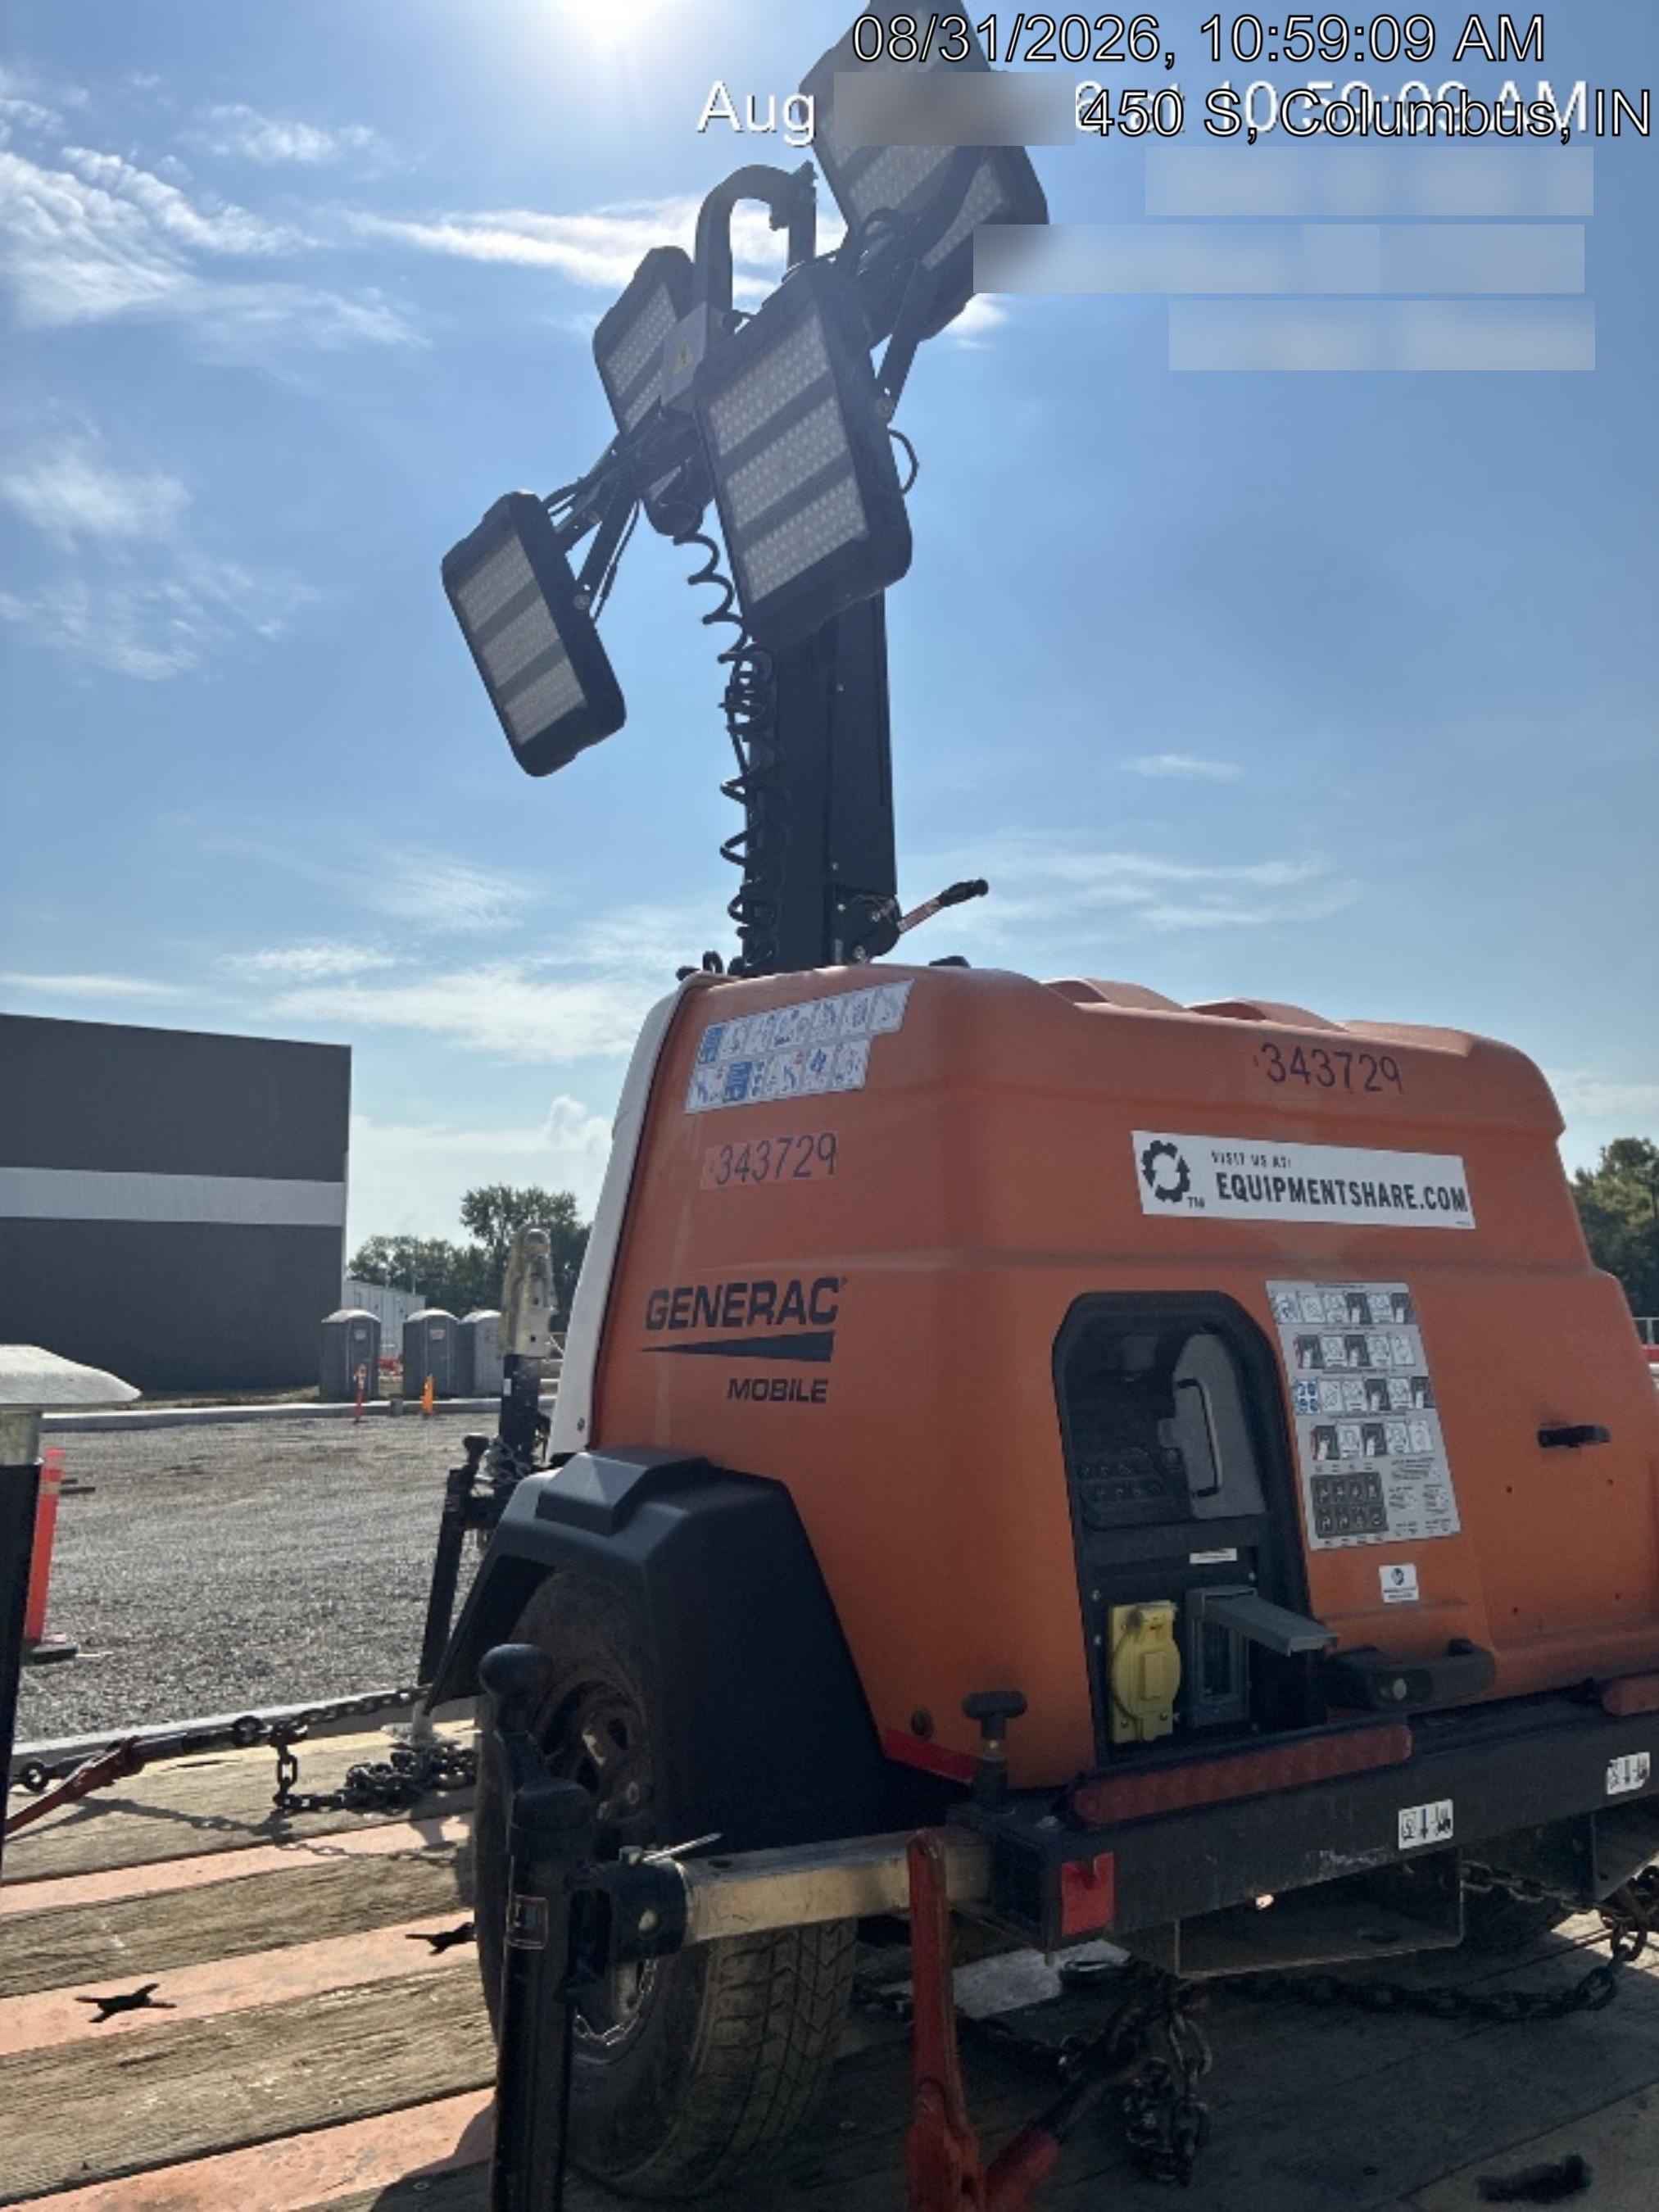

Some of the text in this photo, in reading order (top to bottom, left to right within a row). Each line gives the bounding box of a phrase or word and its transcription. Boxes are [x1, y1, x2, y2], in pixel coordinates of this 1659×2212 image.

[1262, 1043, 1403, 1094] 343729
[714, 1132, 837, 1185] 343729
[1211, 1150, 1244, 1165] VISIT
[1250, 1154, 1267, 1167] US
[1216, 1172, 1469, 1212] EQUIPMENTSHARE.COM
[646, 1276, 840, 1330] GENERAC
[727, 1378, 829, 1403] MOBILE
